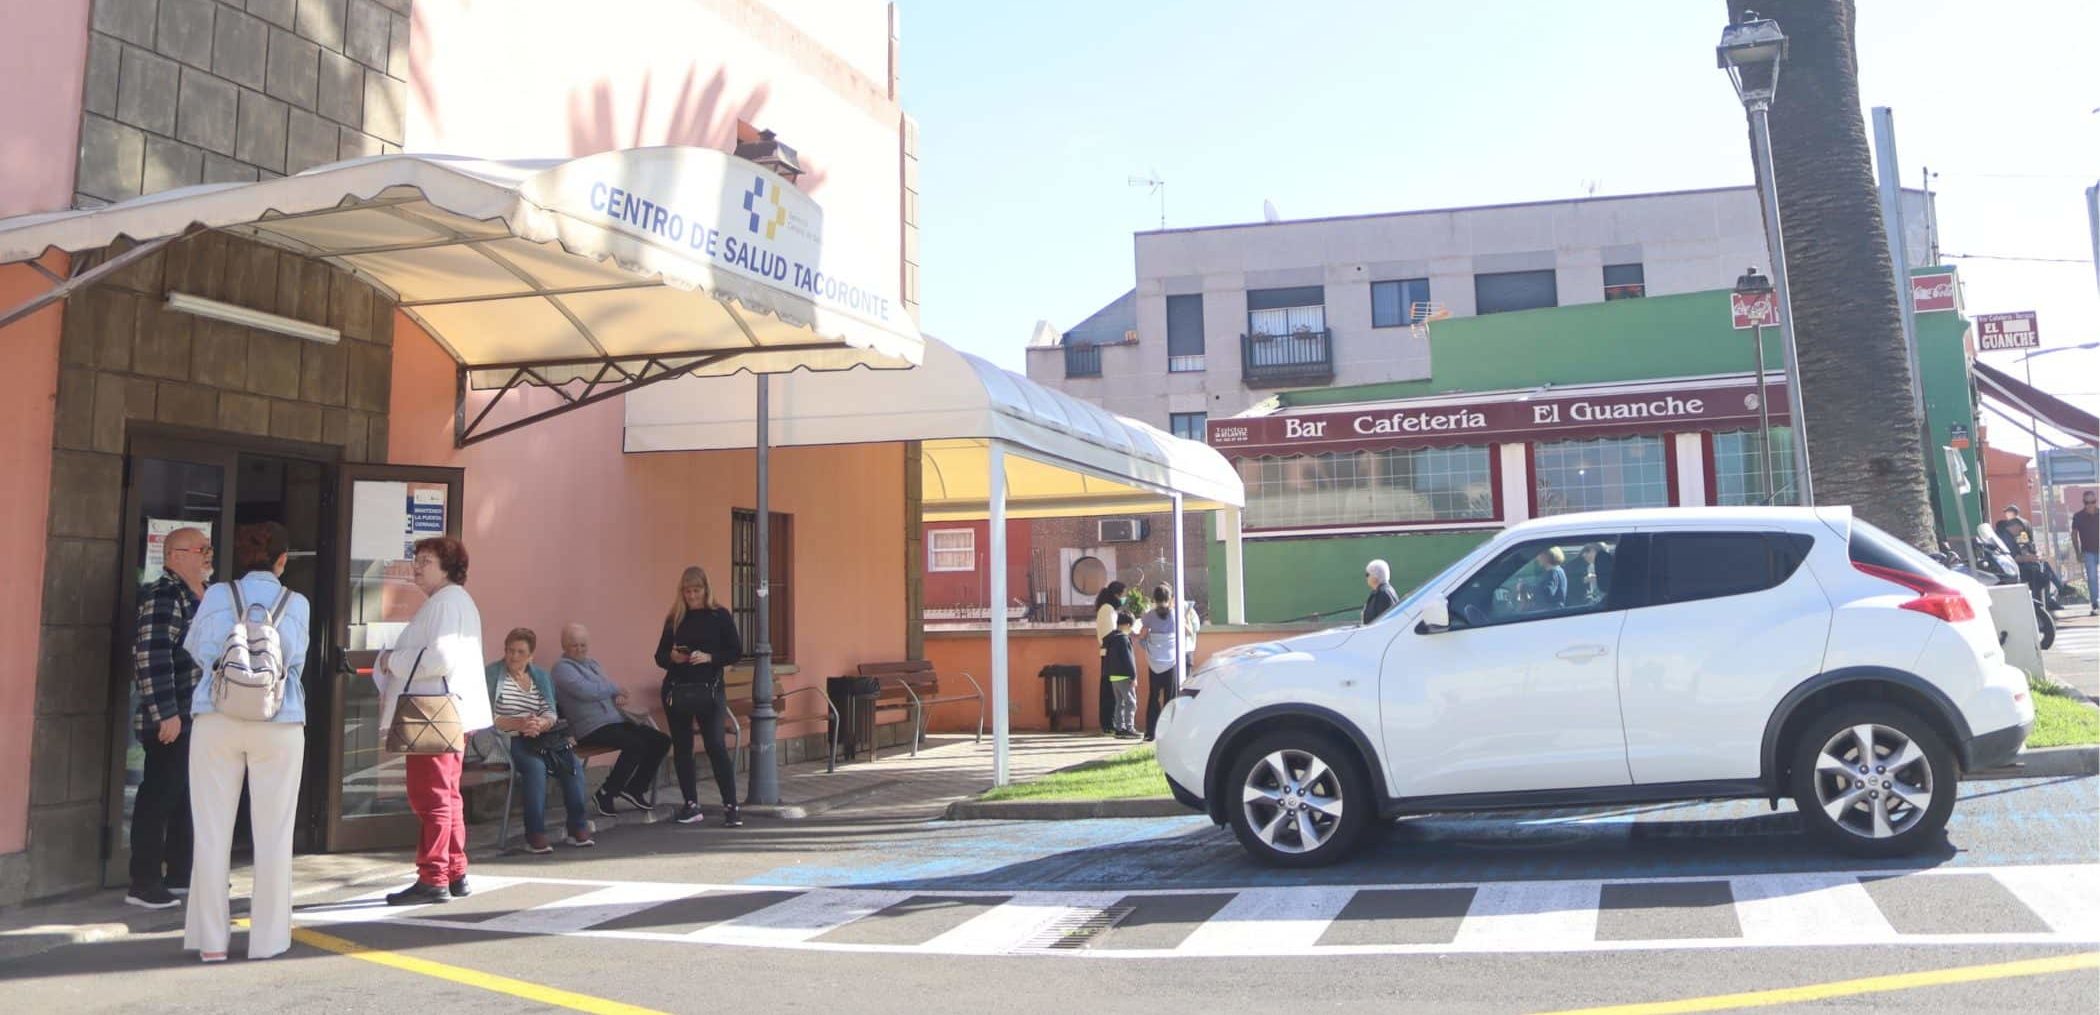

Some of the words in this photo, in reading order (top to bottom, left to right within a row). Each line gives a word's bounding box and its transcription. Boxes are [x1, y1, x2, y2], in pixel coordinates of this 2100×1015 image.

[590, 181, 684, 242] CENTRO
[690, 222, 719, 257] DE
[723, 236, 788, 281] SALUD
[794, 262, 890, 321] TACORONTE
[1982, 331, 2037, 349] GUANCHE
[1984, 322, 2000, 334] EL
[1285, 418, 1327, 439] Bar
[1353, 407, 1487, 436] Cafetería
[1532, 404, 1561, 426] El
[1569, 396, 1705, 422] Guanche
